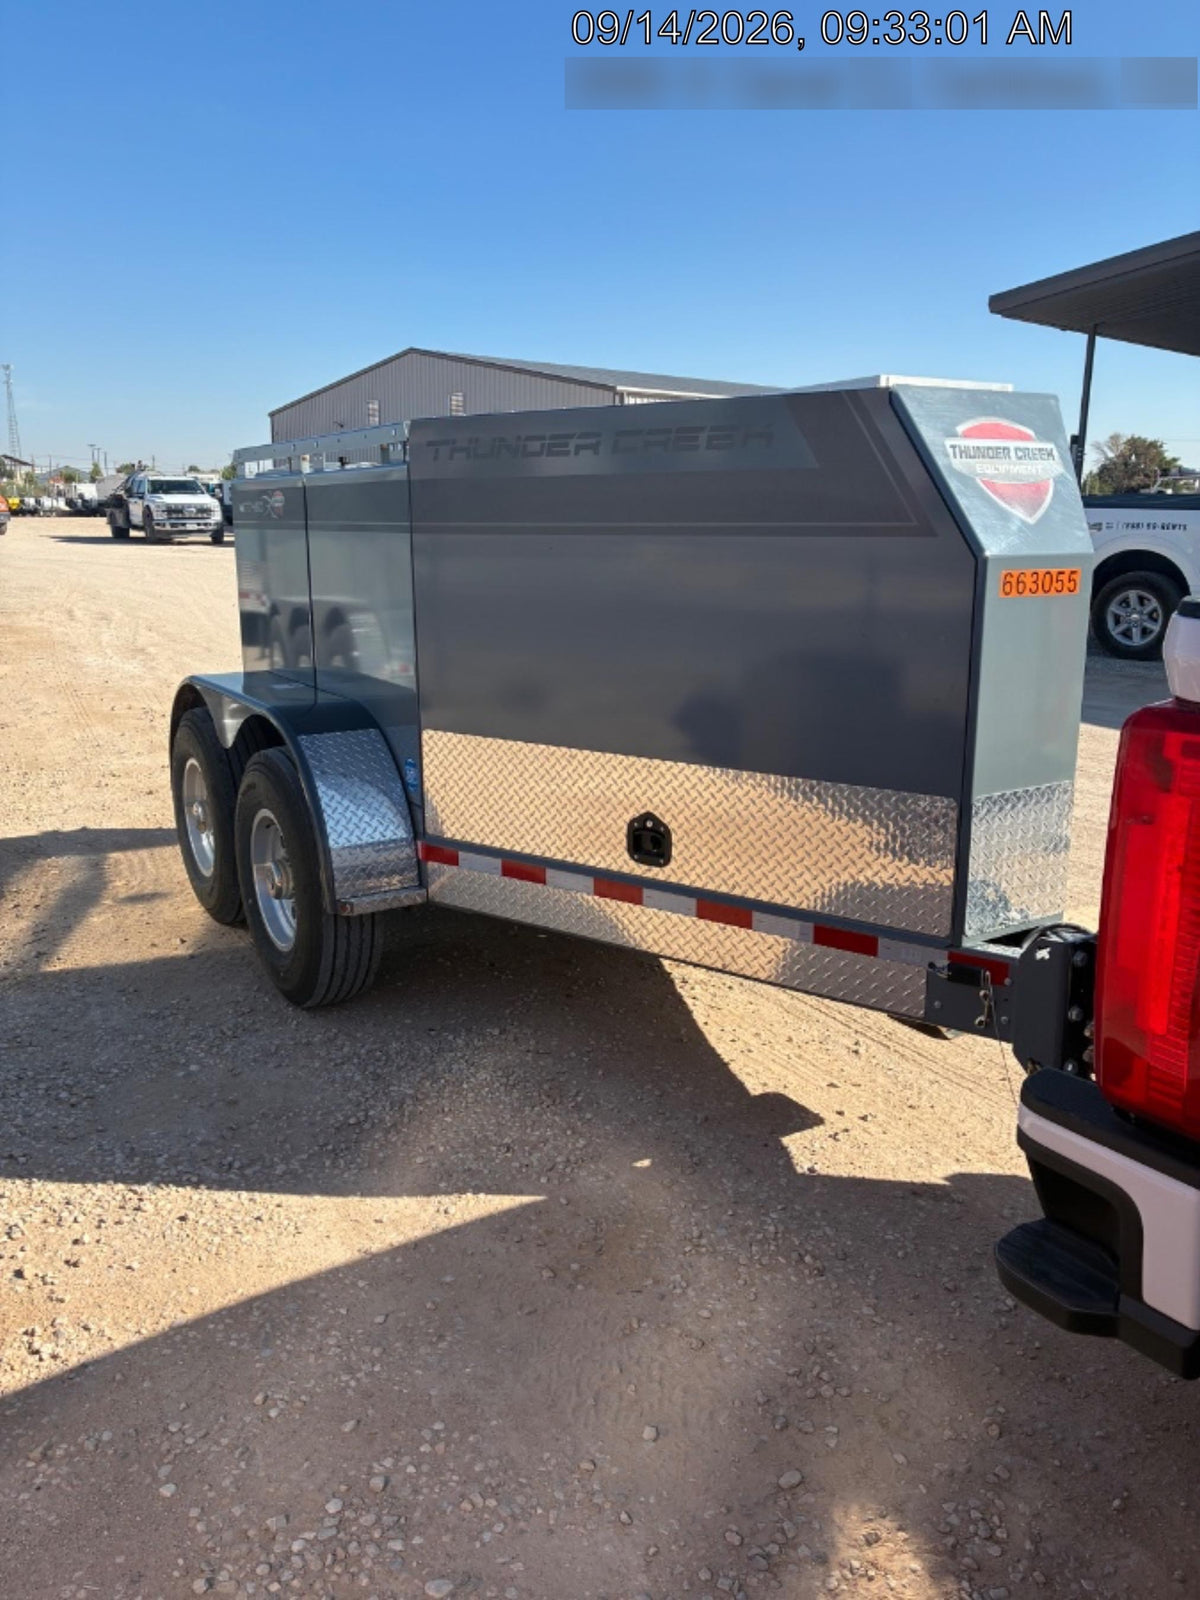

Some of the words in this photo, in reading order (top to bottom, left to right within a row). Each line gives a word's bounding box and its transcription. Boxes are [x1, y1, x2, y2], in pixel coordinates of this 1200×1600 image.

[426, 431, 602, 463] THUNDER
[611, 422, 776, 455] CREEK
[949, 444, 1012, 461] THUNDER
[1014, 447, 1056, 462] CREEK
[1002, 570, 1078, 596] 663055
